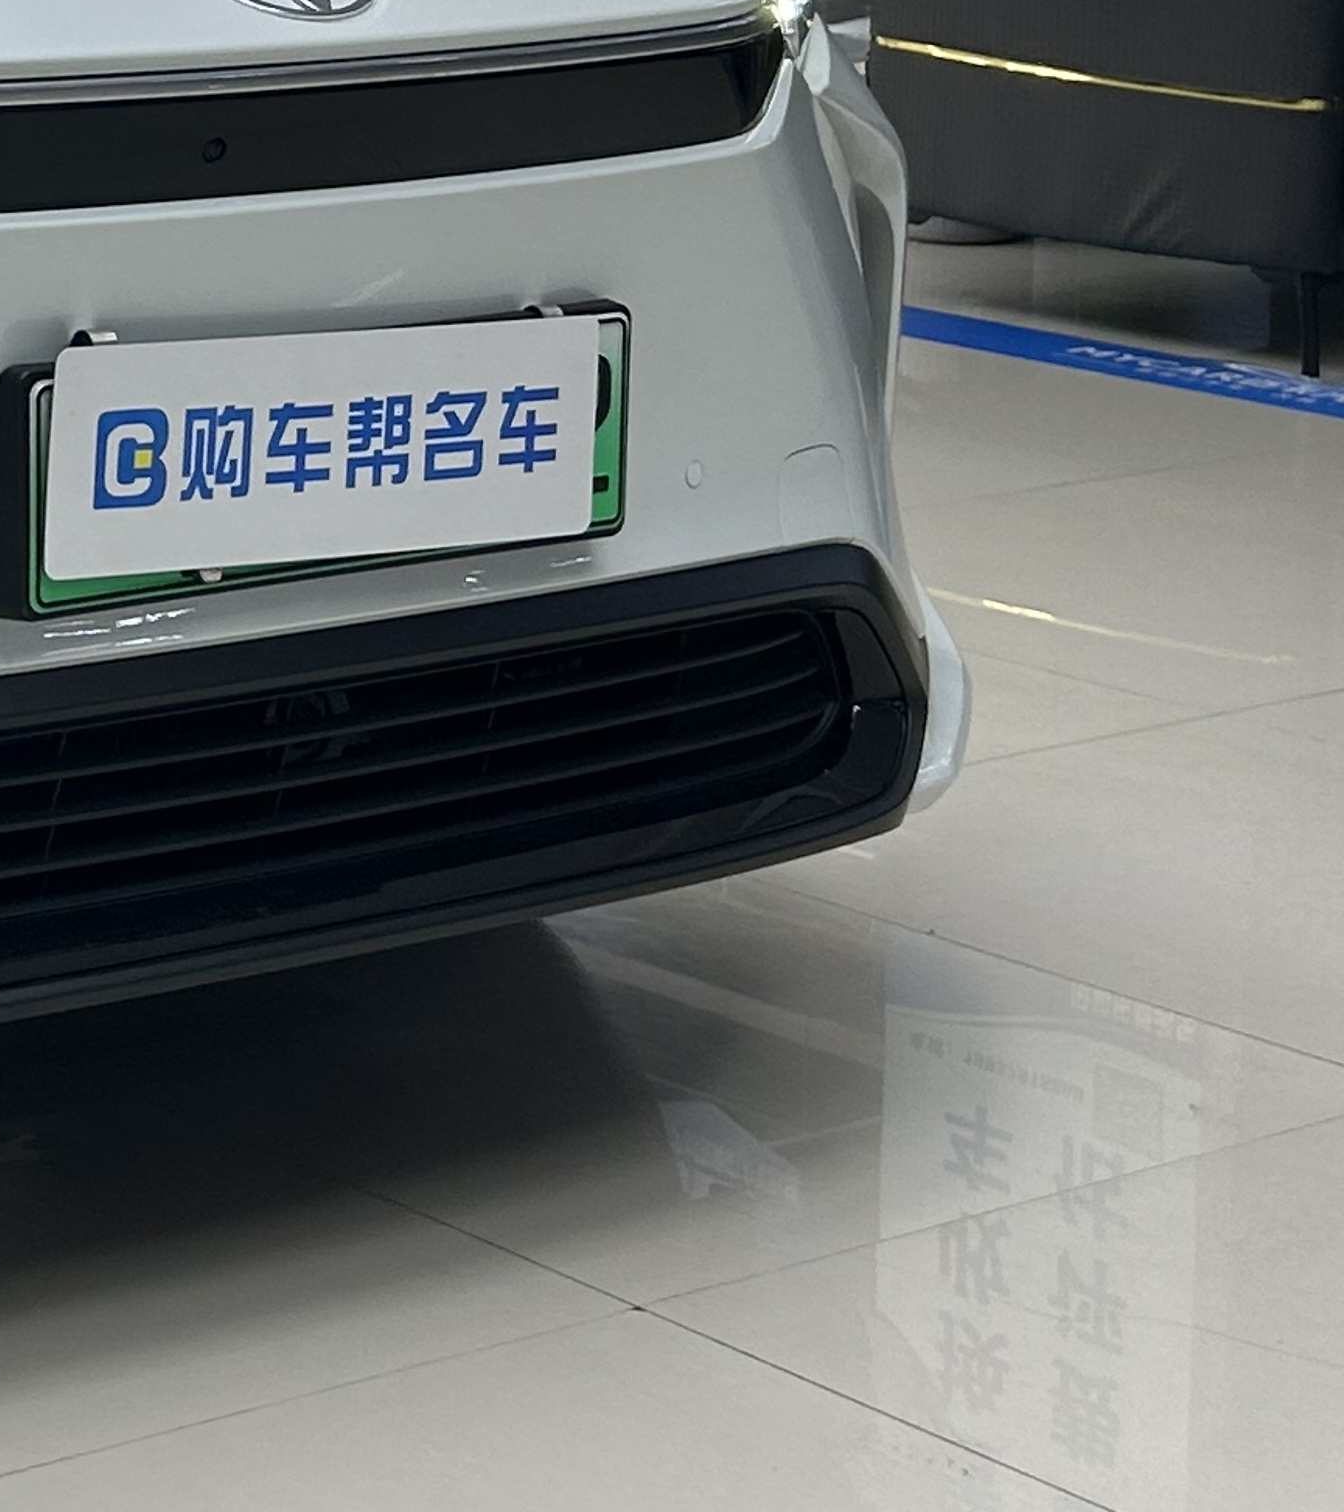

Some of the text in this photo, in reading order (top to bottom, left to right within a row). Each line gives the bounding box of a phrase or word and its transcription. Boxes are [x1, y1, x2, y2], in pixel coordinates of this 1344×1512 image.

[179, 384, 560, 502] 购车帮名车
